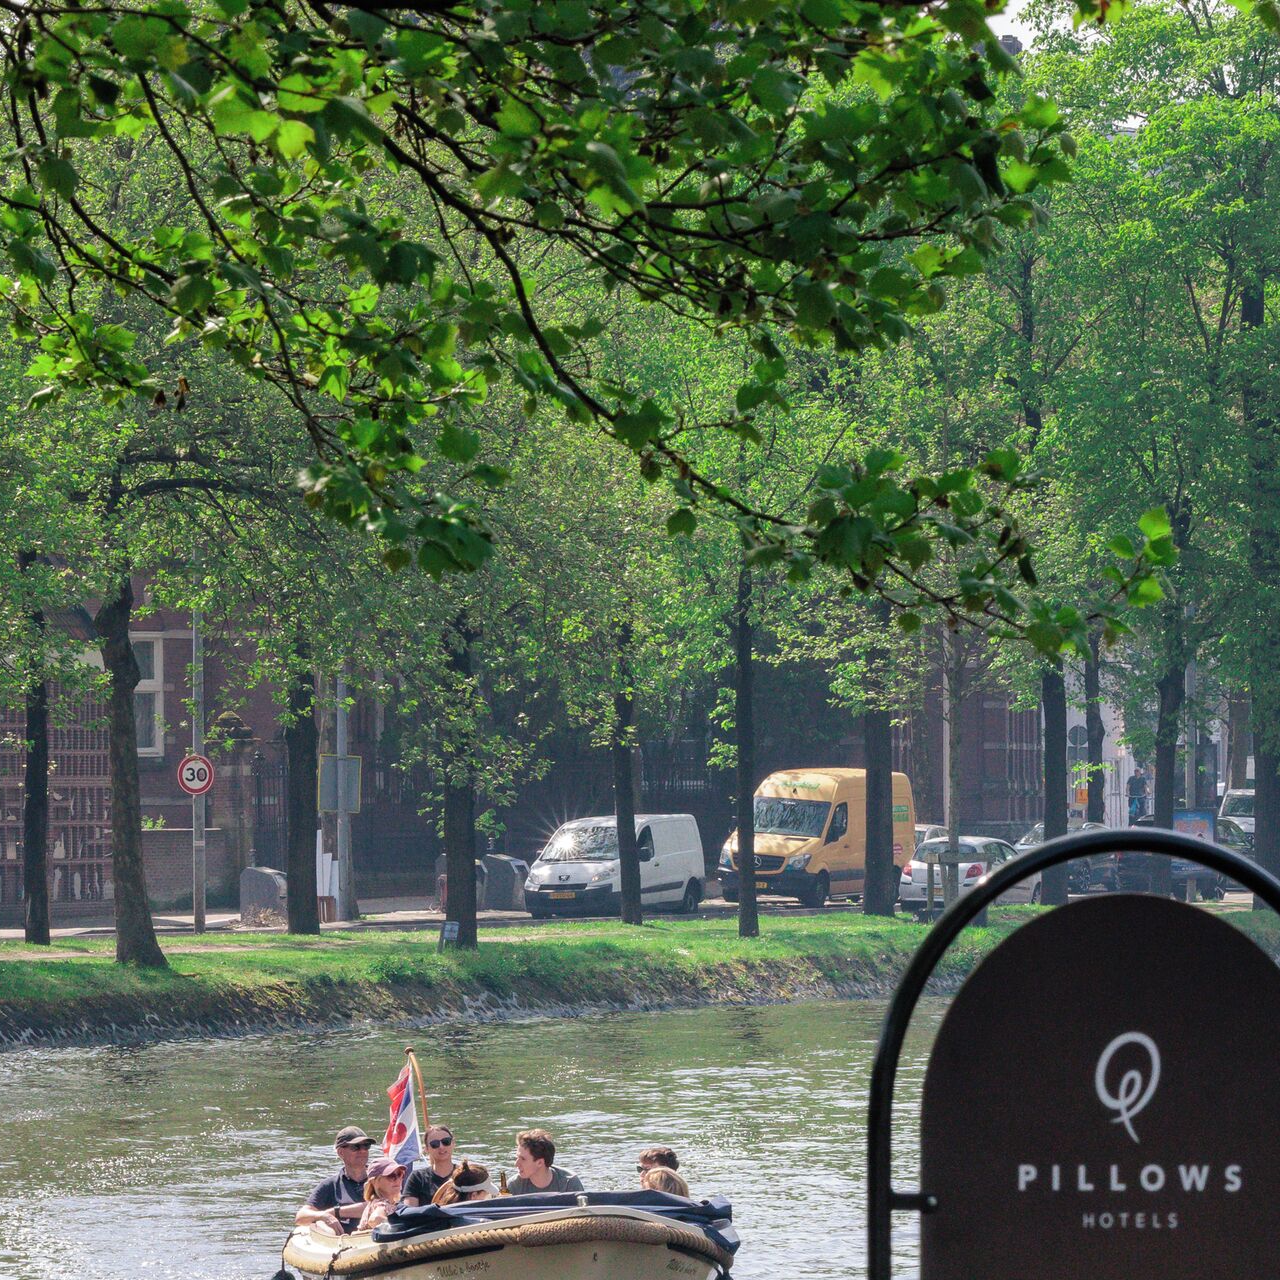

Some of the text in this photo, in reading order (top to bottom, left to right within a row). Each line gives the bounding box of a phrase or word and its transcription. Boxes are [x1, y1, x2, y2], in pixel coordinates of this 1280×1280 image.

[185, 767, 207, 782] 30
[1018, 1164, 1243, 1192] PILLOWS
[1082, 1212, 1179, 1229] HOTELS
